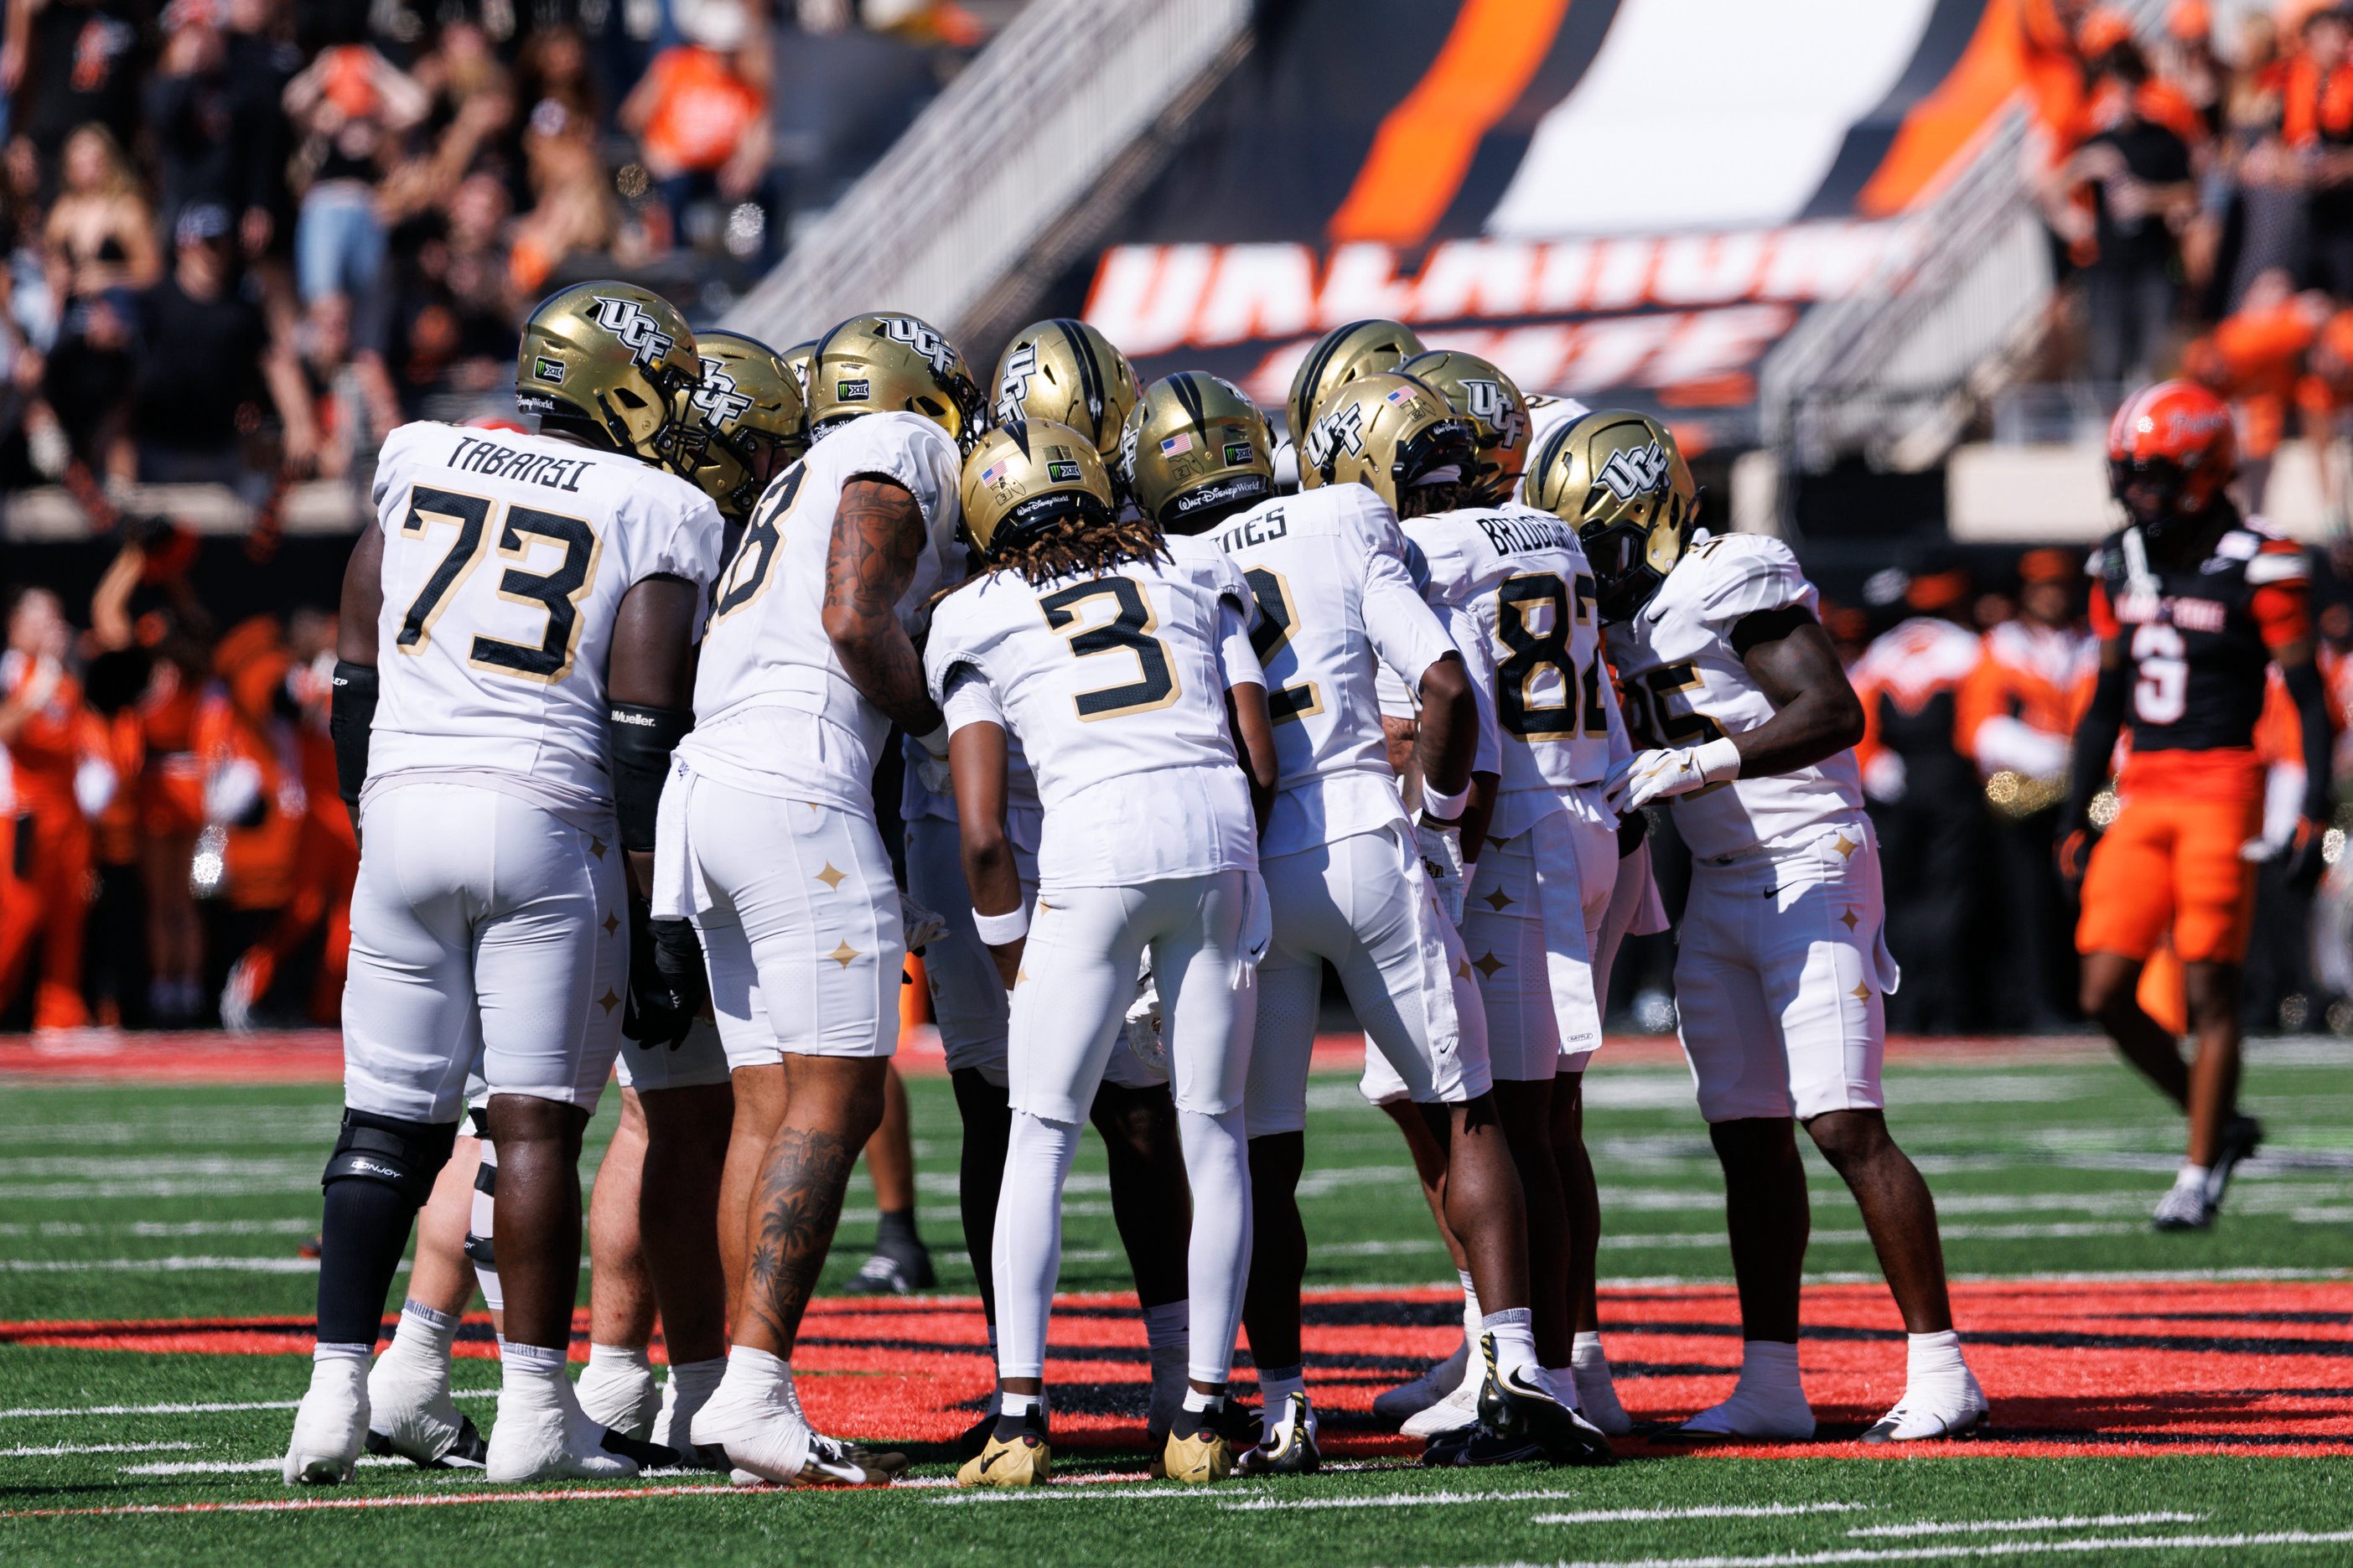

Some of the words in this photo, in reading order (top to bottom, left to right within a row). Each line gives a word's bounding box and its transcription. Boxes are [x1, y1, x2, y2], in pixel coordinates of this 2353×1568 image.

[593, 296, 676, 367] UCF
[874, 317, 956, 375] UCF
[848, 384, 868, 396] XII
[995, 338, 1038, 423] UCF
[1456, 379, 1526, 450] UCF
[447, 437, 597, 492] TABANSI
[1591, 438, 1672, 503] UCF
[1000, 493, 1008, 502] 3
[702, 457, 811, 639] 8
[1210, 506, 1288, 553] NES
[396, 484, 604, 686] 73
[1035, 577, 1182, 723] 3
[611, 710, 654, 727] Mueller
[351, 1161, 402, 1178] DONJOY
